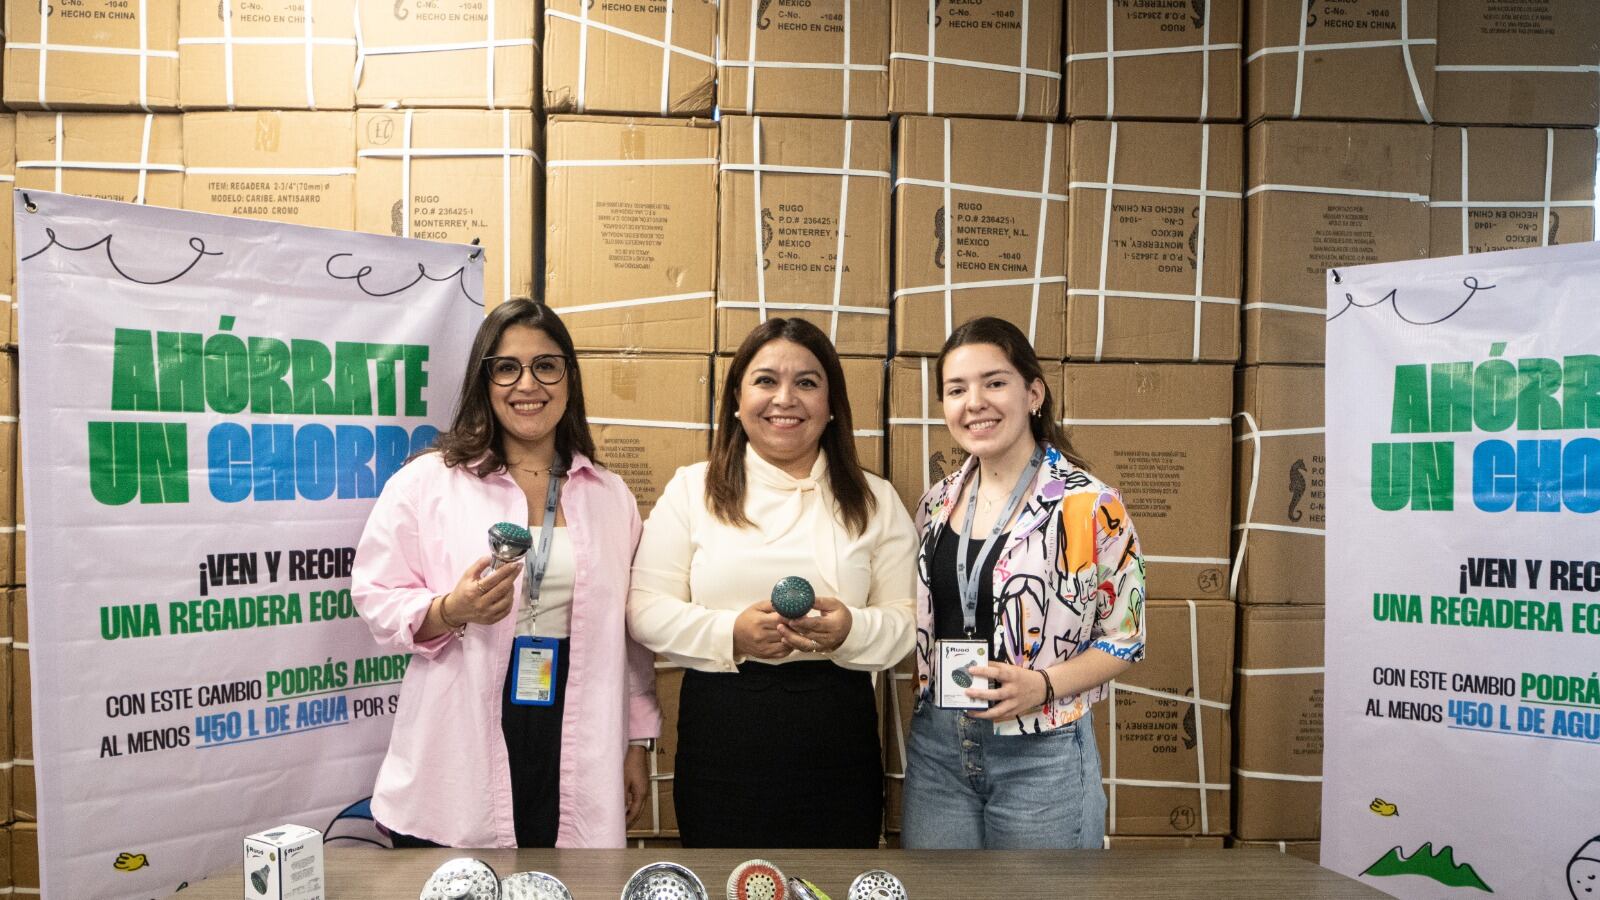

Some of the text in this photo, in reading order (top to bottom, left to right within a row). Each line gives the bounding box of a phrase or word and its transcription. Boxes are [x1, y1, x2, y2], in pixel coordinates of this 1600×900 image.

[602, 3, 675, 14] HECHO EN CHIN
[61, 10, 136, 20] HECHO EN CHINA
[240, 14, 271, 23] HECHO
[273, 15, 286, 23] EN
[416, 13, 446, 21] HECHO
[448, 13, 460, 21] EN
[778, 22, 845, 33] HECHO EN CHIN
[949, 20, 1022, 29] HECHO EN CHINA
[1324, 20, 1397, 30] HECHO EN CHINA
[231, 182, 270, 190] REGADERA
[211, 194, 244, 203] MODELO:
[415, 195, 440, 203] RUGO
[232, 206, 299, 215] ACABADO CROMO
[779, 204, 804, 212] RUGO
[958, 202, 983, 211] RUGO
[1112, 204, 1185, 214] HECHO EN CHINA
[1468, 210, 1538, 219] HECHO EN CHINA
[1013, 229, 1029, 237] N.L.
[778, 263, 808, 271] HECHO
[810, 264, 822, 272] EN
[956, 262, 1028, 272] HECHO EN CHINA
[1158, 265, 1183, 273] RUGO
[111, 315, 429, 417] AHÓRRATE
[88, 421, 190, 506] UN
[1371, 441, 1455, 511] UN
[199, 547, 357, 596] ¡VEN Y RECIB
[1459, 558, 1517, 594] ¡VEN
[1525, 560, 1542, 589] Y
[100, 588, 361, 640] UNA REGADERA ECO
[1373, 593, 1423, 623] UNA
[1430, 596, 1563, 632] REGADERA
[1373, 667, 1405, 687] CON
[1410, 670, 1447, 690] ESTE
[1452, 674, 1515, 696] CAMBIO
[106, 696, 145, 718] CON
[151, 688, 193, 713] ESTE
[197, 680, 262, 707] CAMBIO
[266, 657, 347, 697] PODRÁS
[1365, 698, 1384, 718] AL
[1388, 701, 1442, 723] MENOS
[1448, 700, 1493, 728] 450
[1500, 705, 1511, 730] L
[1518, 707, 1545, 733] DE
[99, 735, 123, 758] AL
[128, 726, 190, 755] MENOS
[196, 710, 241, 743] 450
[248, 709, 259, 737] L
[265, 704, 290, 734] DE
[296, 695, 348, 728] AGUA
[353, 696, 384, 719] POR
[1152, 745, 1177, 753] RUGO
